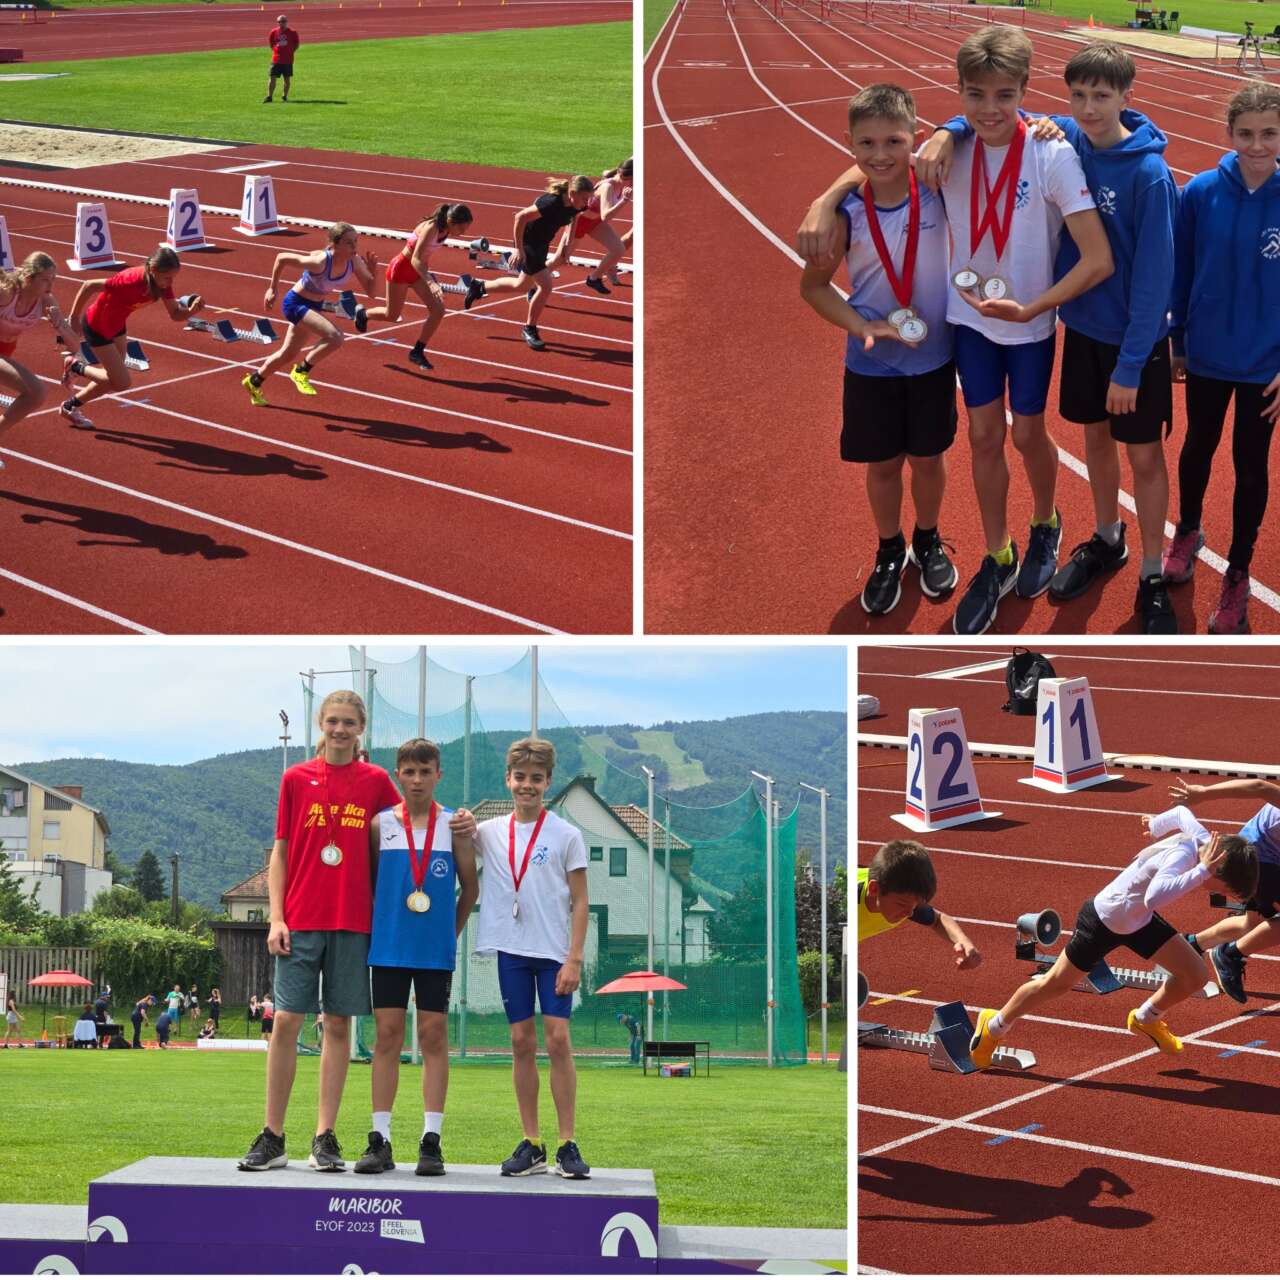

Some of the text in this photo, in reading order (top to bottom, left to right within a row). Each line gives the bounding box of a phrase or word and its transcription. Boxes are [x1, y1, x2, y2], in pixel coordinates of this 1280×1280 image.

[180, 201, 199, 237] 2
[259, 186, 271, 220] 1
[85, 216, 106, 252] 3
[1042, 701, 1054, 764] 1
[1070, 698, 1091, 761] 1
[910, 733, 922, 800] 2
[932, 731, 969, 801] 2
[328, 1197, 403, 1215] MARIBOR
[315, 1220, 375, 1233] EYOF 2023
[382, 1228, 418, 1236] SLOVENIA
